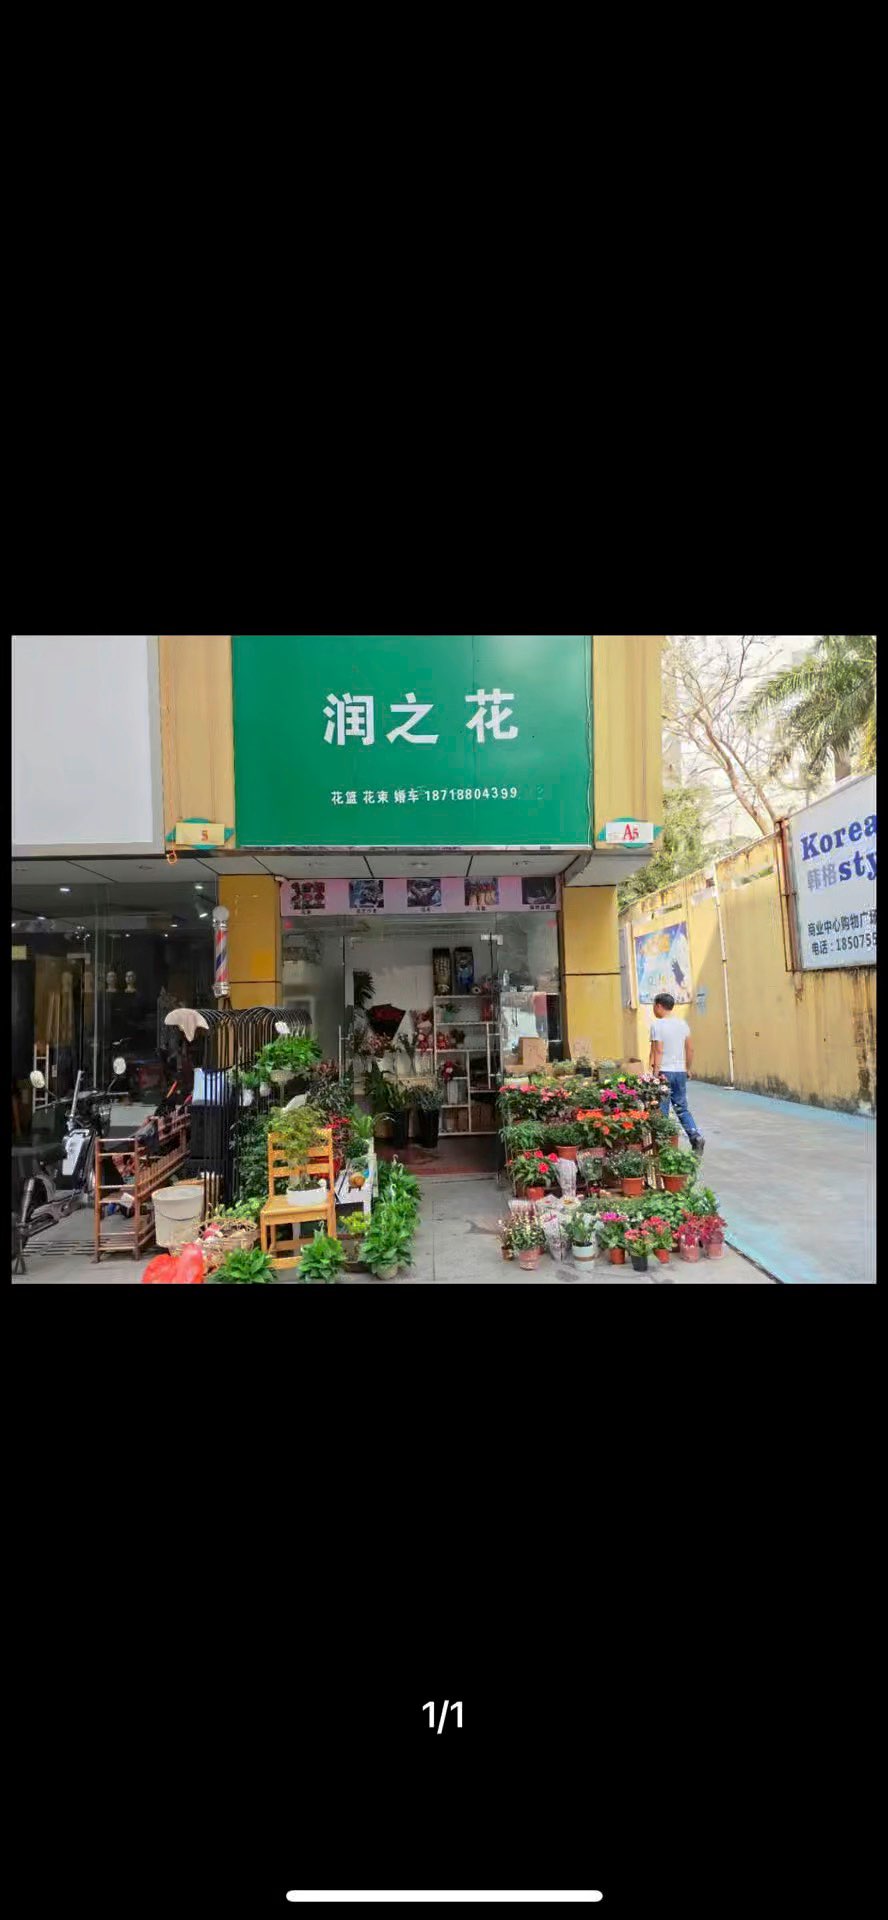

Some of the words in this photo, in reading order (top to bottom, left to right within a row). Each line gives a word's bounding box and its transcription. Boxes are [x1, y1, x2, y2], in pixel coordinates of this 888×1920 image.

[424, 787, 518, 801] 18718804399
[623, 824, 640, 841] A5
[800, 814, 877, 861] Korea
